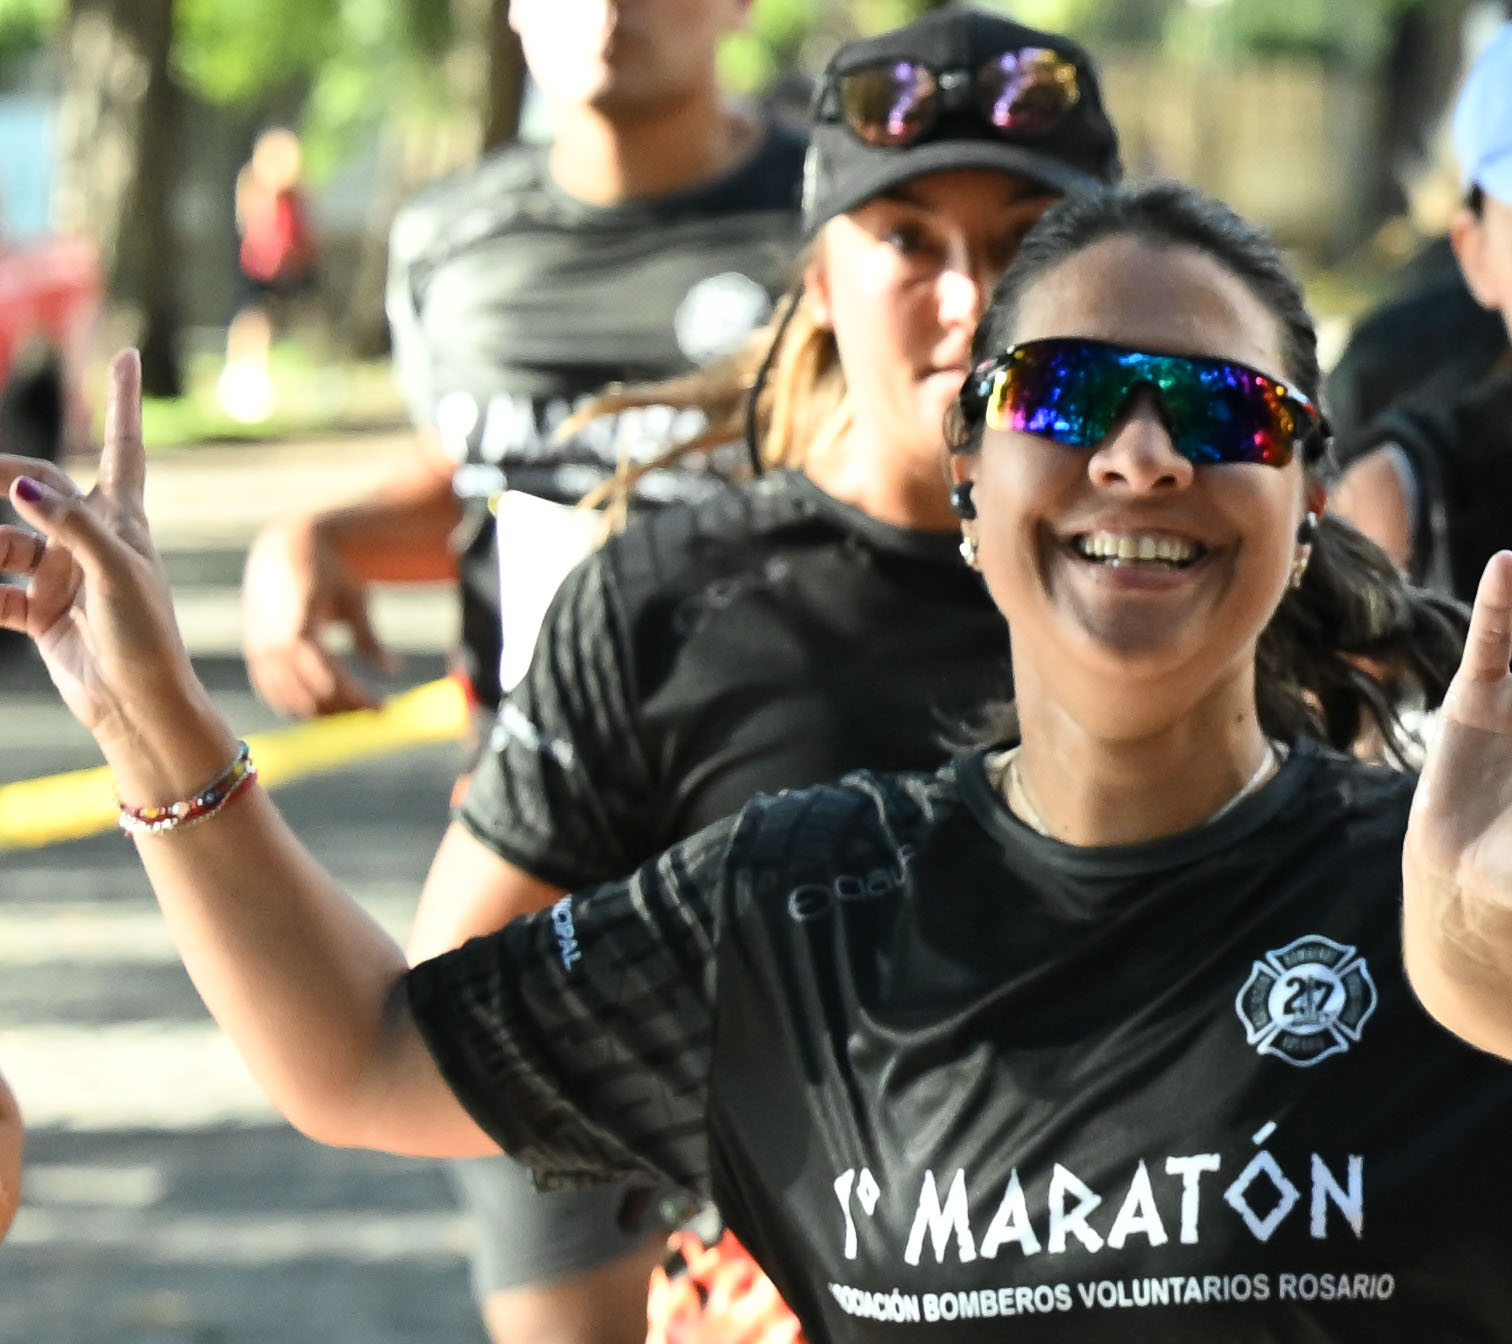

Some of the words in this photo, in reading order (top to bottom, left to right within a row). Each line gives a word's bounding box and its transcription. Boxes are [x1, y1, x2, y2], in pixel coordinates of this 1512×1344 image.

[1282, 976, 1335, 1016] 27
[904, 1119, 1364, 1268] MARATÓN
[922, 1283, 1073, 1323] BOMBEROS
[1077, 1272, 1271, 1310] VOLUNTARIOS
[1278, 1272, 1396, 1301] ROSARIO
